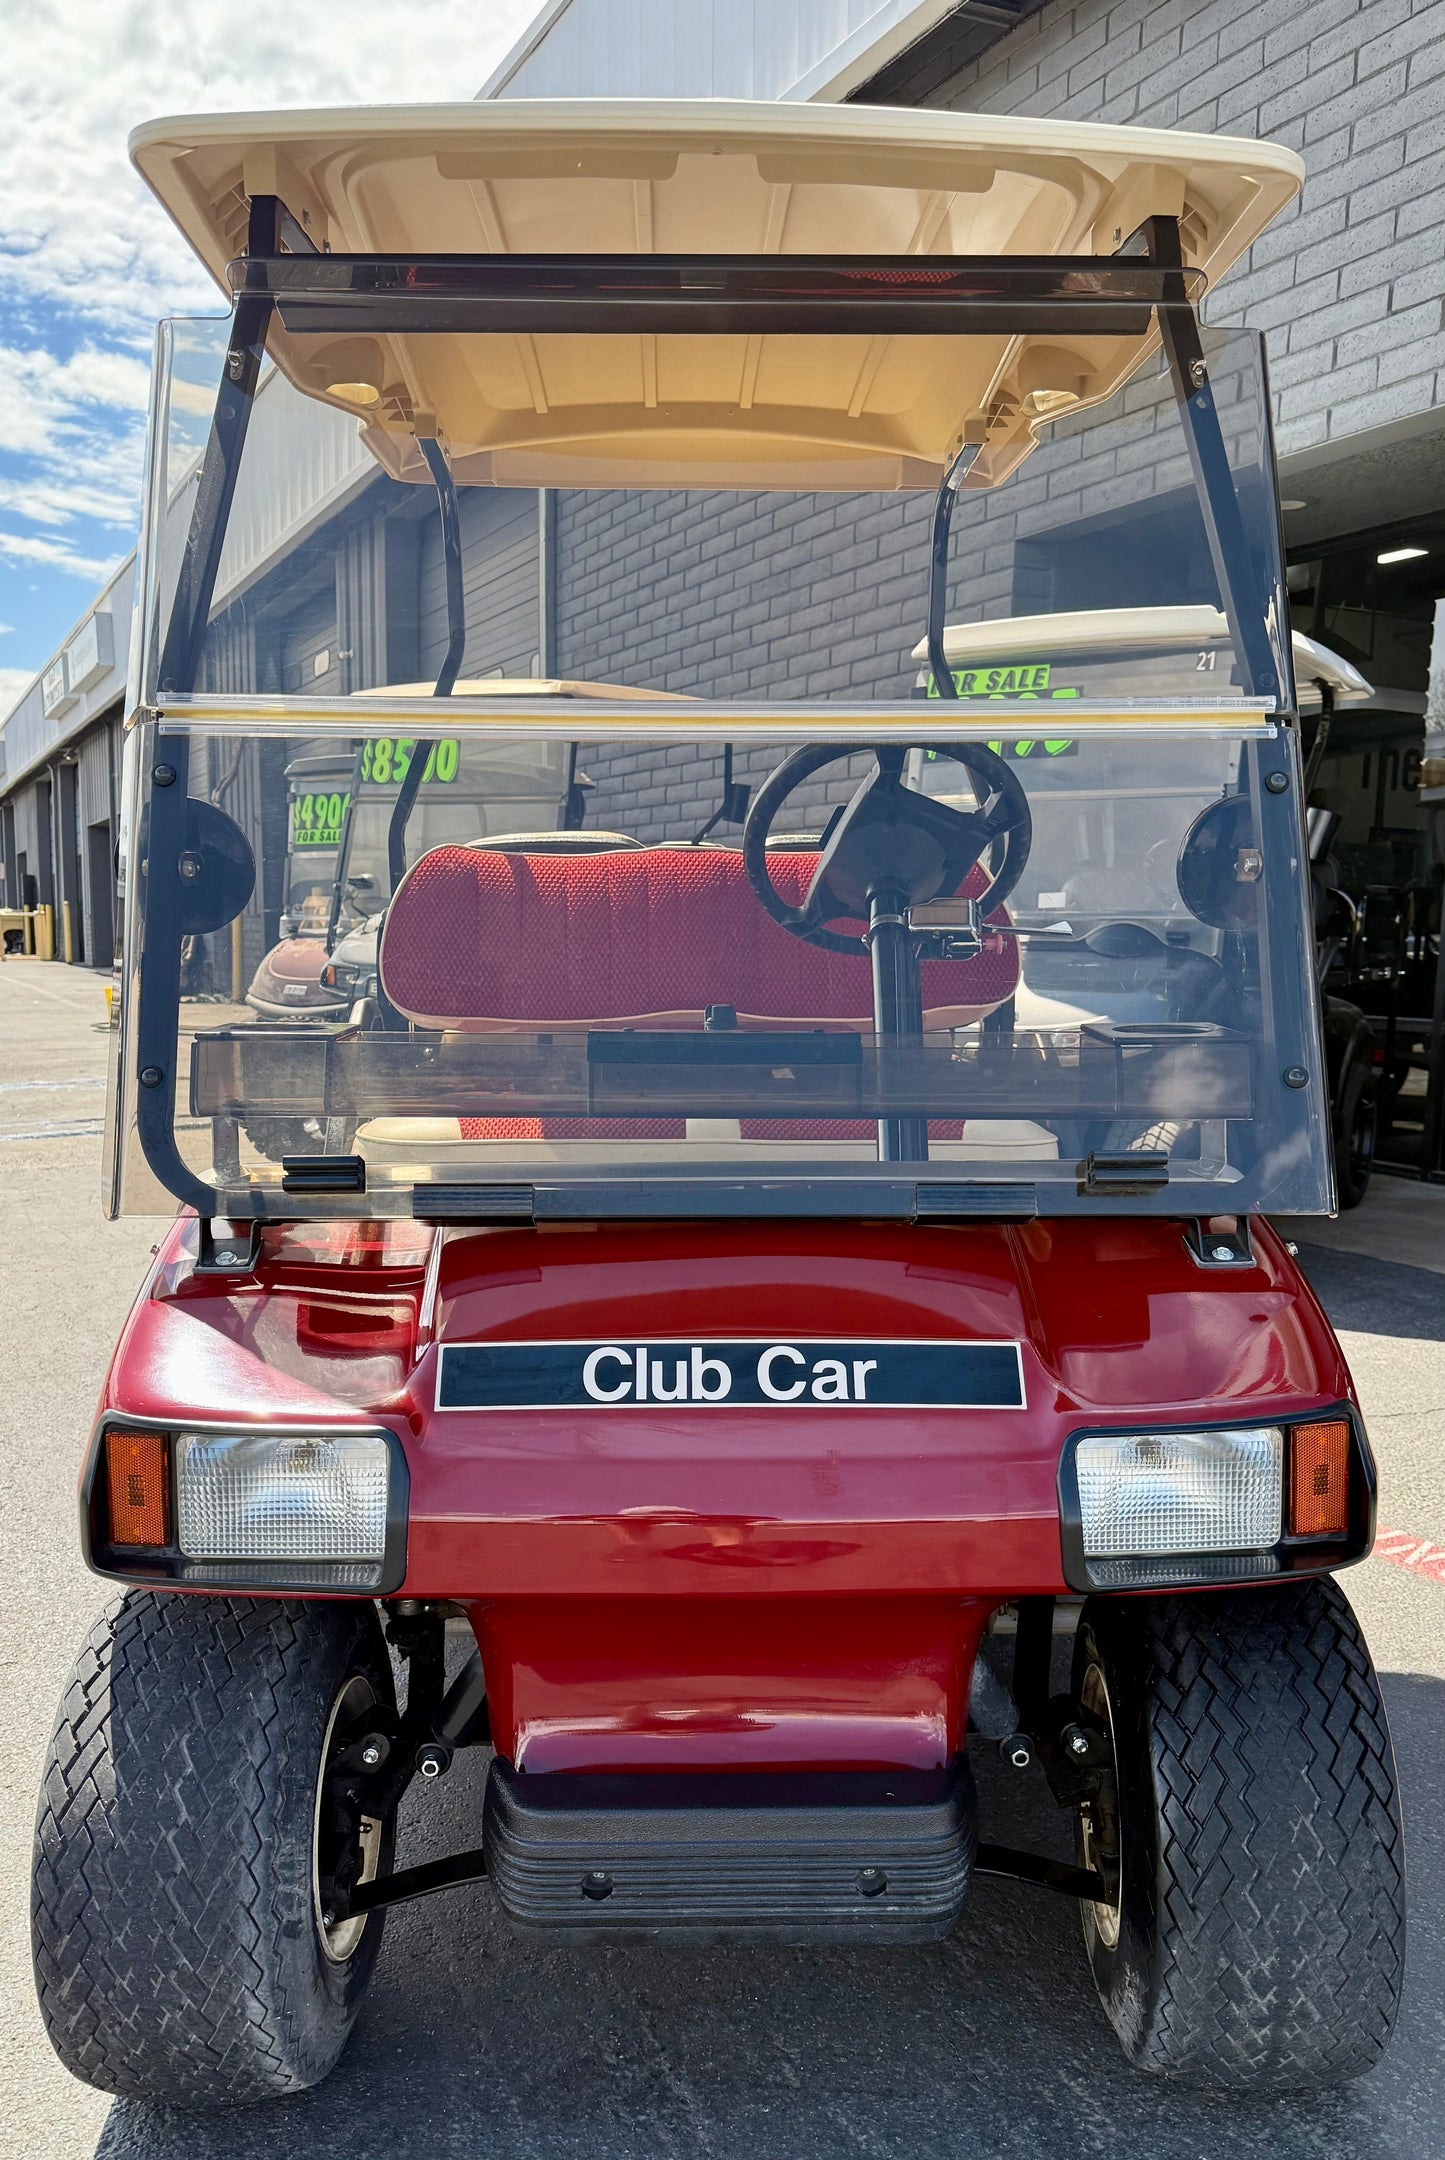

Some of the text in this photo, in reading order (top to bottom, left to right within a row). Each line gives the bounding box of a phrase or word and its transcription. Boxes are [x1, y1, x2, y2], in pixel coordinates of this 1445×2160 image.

[1196, 651, 1216, 670] 21
[986, 668, 1048, 691] SALE
[297, 831, 315, 842] FOR
[582, 1345, 877, 1401] Club Car
